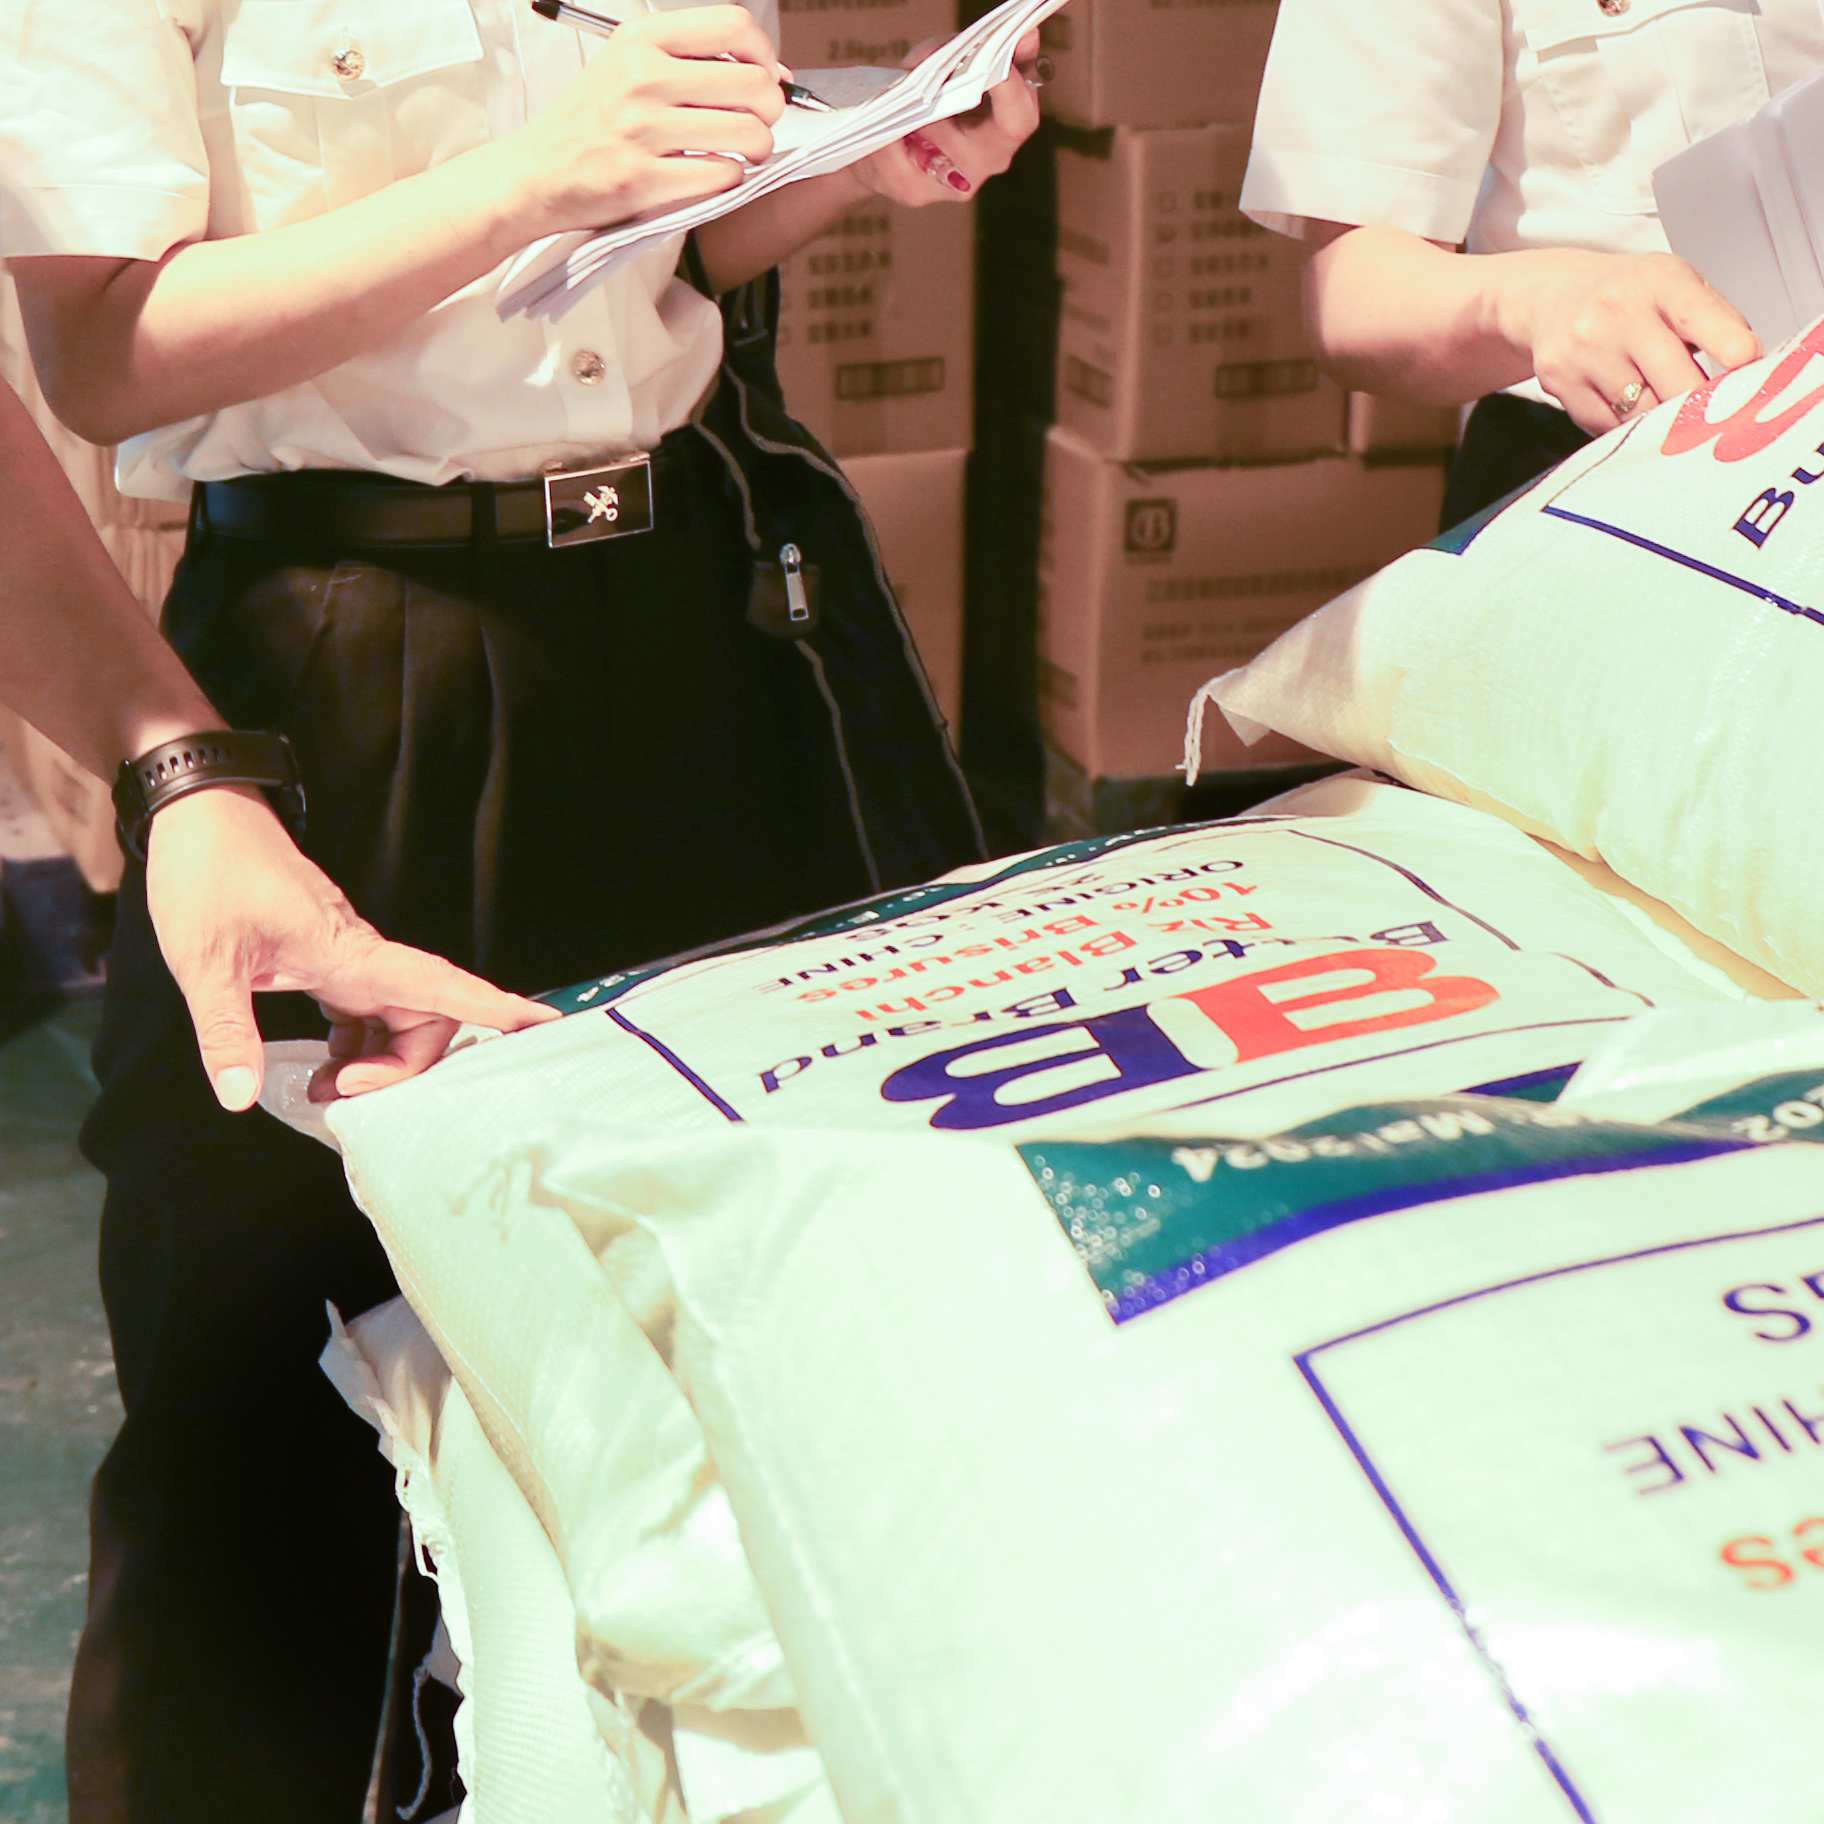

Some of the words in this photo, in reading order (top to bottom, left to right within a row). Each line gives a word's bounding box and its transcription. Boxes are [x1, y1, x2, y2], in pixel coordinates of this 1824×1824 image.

[998, 858, 1246, 924] ORIGINE
[1112, 880, 1260, 915] 10%
[1146, 911, 1276, 934] Riz
[753, 932, 945, 994] CHINE
[796, 914, 1100, 1004] Brisures
[854, 929, 1138, 1022] Blanchi
[759, 986, 1078, 1094] Brand
